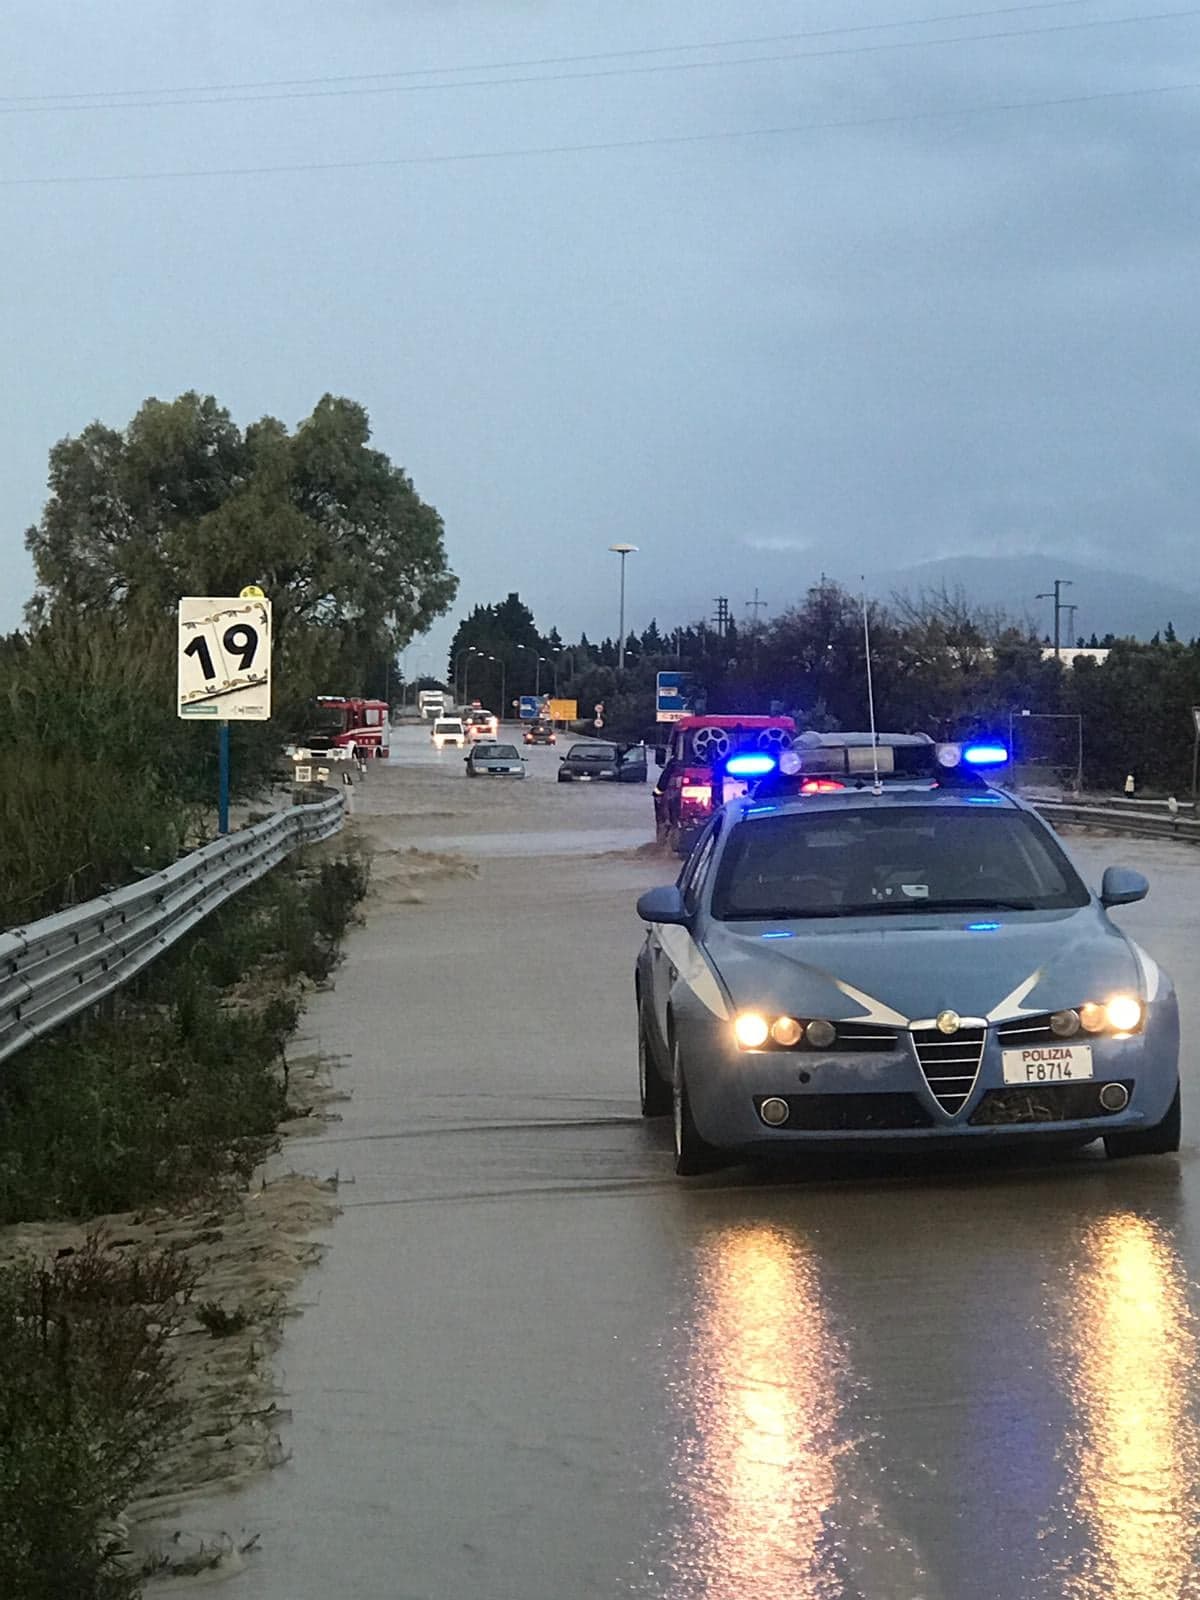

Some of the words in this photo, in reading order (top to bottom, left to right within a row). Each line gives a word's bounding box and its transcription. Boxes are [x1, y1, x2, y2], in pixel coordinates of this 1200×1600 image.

[183, 623, 259, 681] 19
[1022, 1048, 1073, 1062] POLIZIA
[1026, 1062, 1072, 1081] F8714
